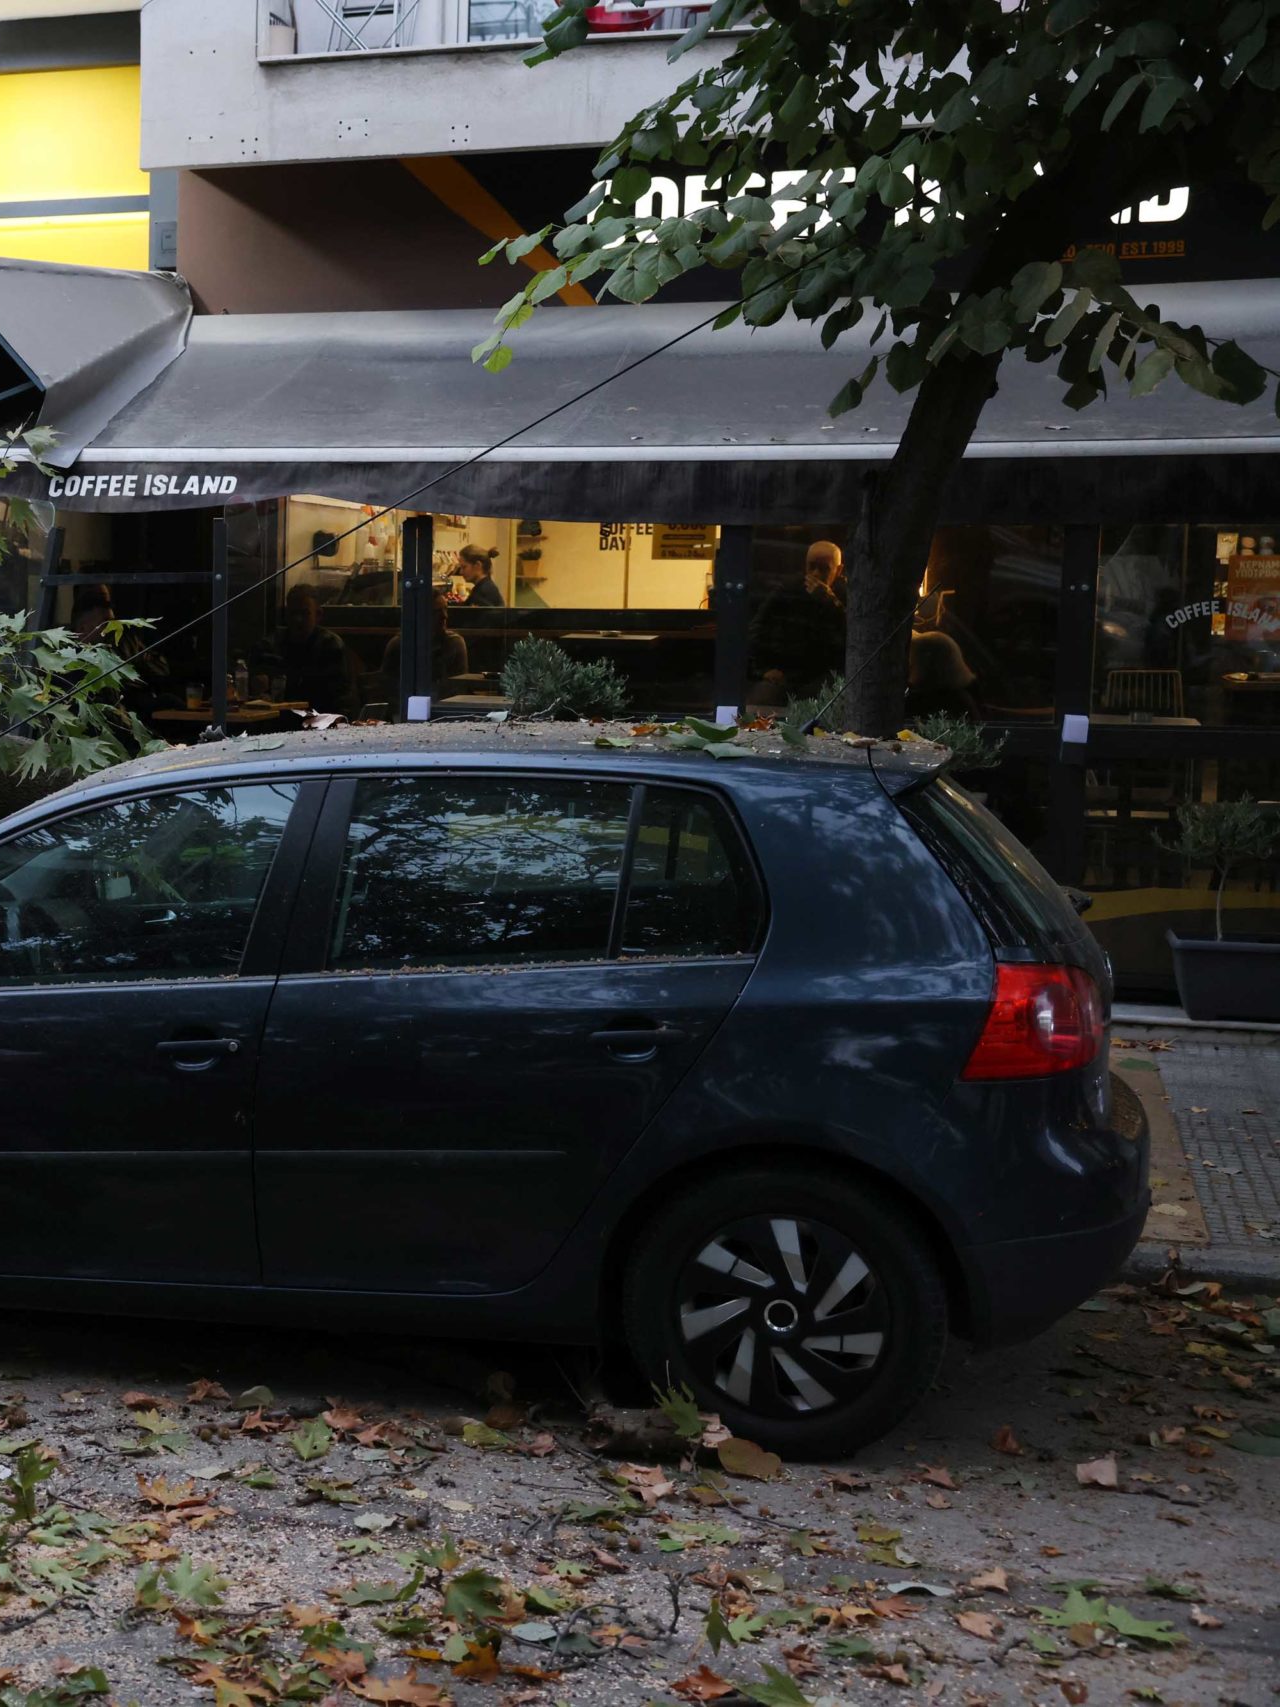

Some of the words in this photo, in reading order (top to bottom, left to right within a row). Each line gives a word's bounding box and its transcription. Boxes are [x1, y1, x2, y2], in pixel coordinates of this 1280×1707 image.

[48, 475, 138, 497] COFFEE
[143, 474, 238, 496] ISLAND
[1165, 600, 1220, 629] COFFEE
